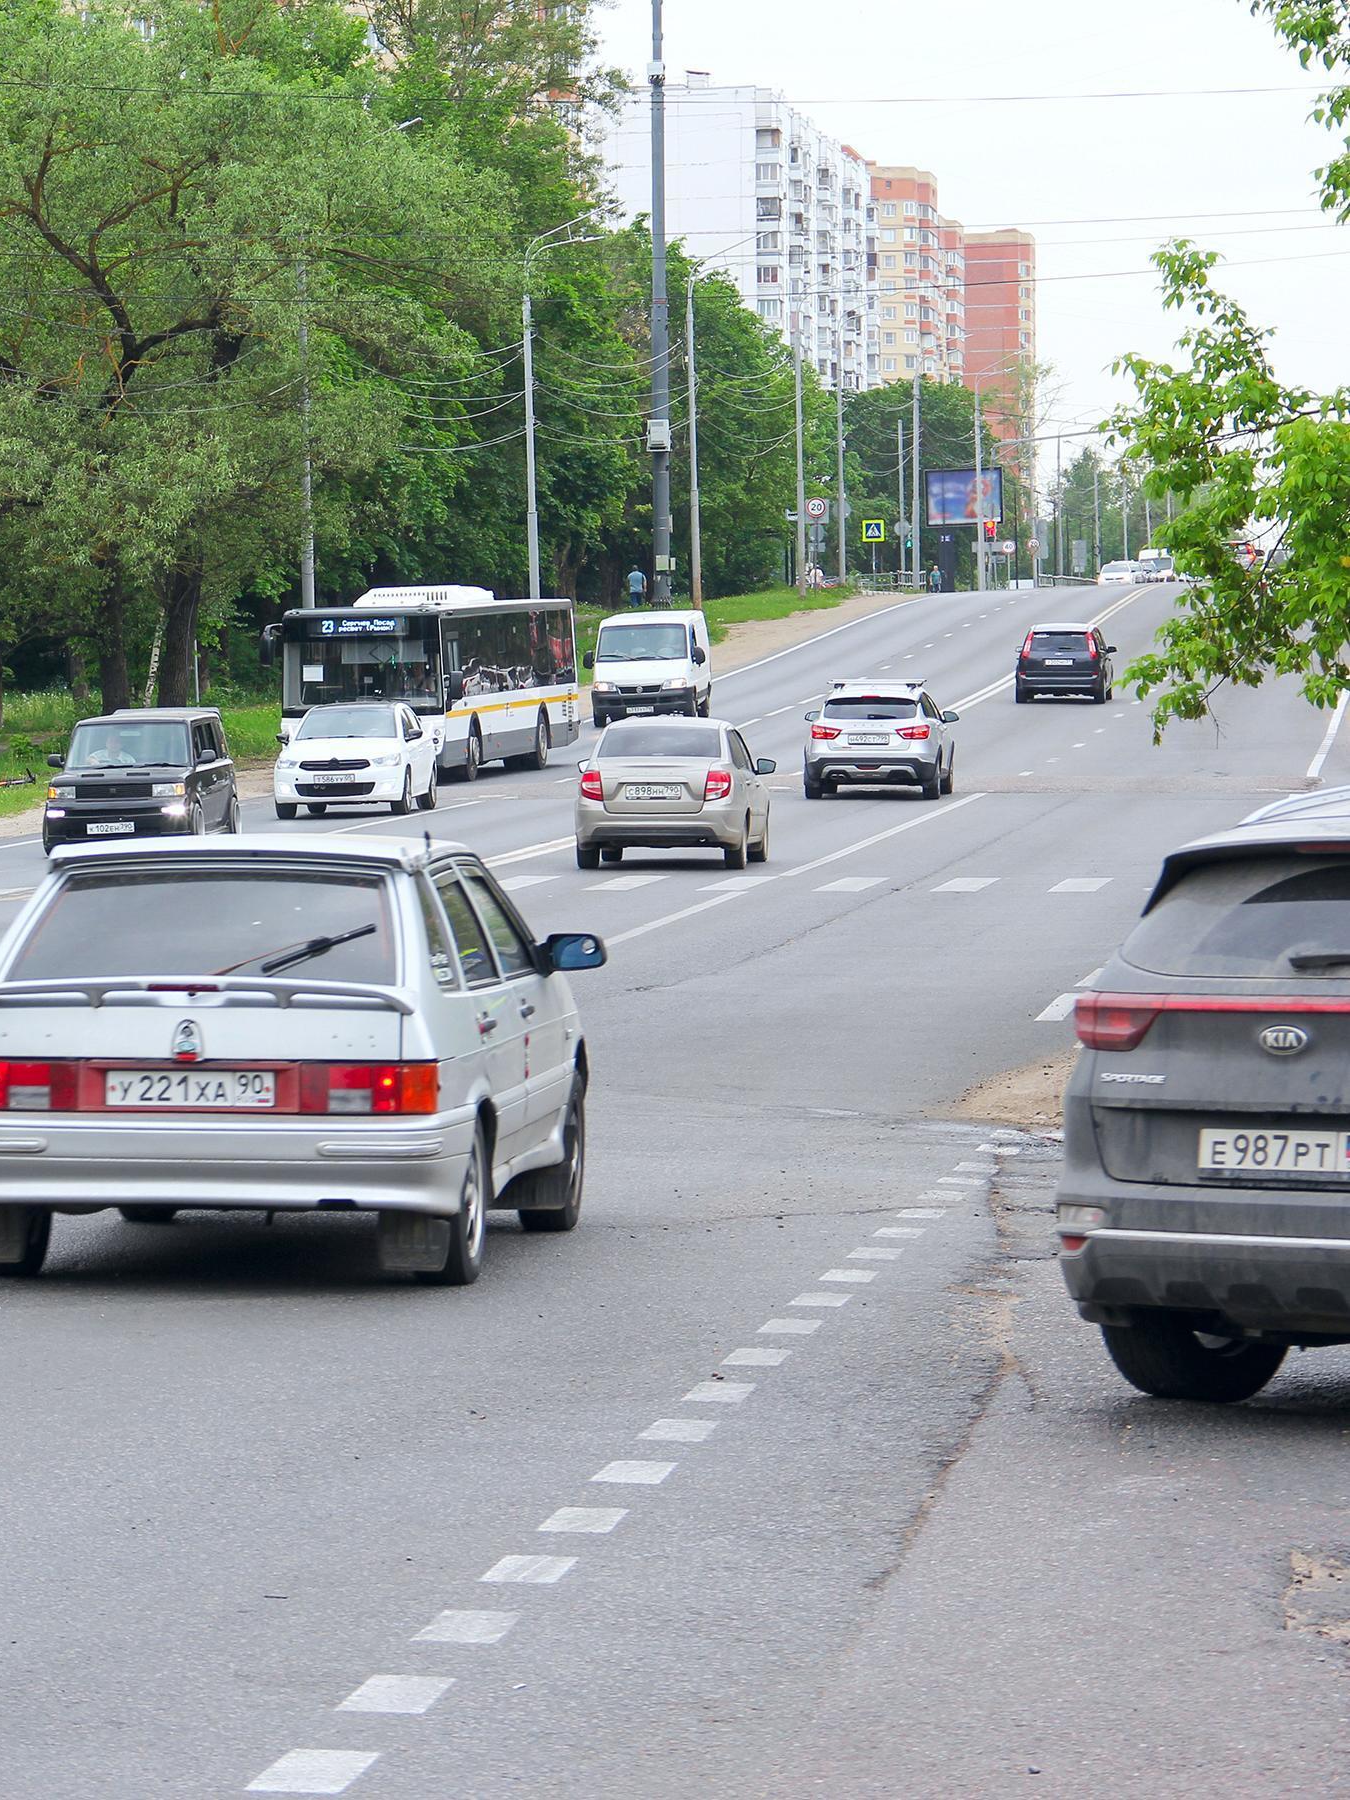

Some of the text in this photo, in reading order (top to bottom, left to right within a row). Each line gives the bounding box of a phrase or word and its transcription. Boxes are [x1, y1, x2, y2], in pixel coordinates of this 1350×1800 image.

[811, 503, 822, 511] 20
[321, 620, 334, 633] 23
[1265, 1031, 1299, 1048] KIA
[1100, 1072, 1167, 1085] SPORTAGE
